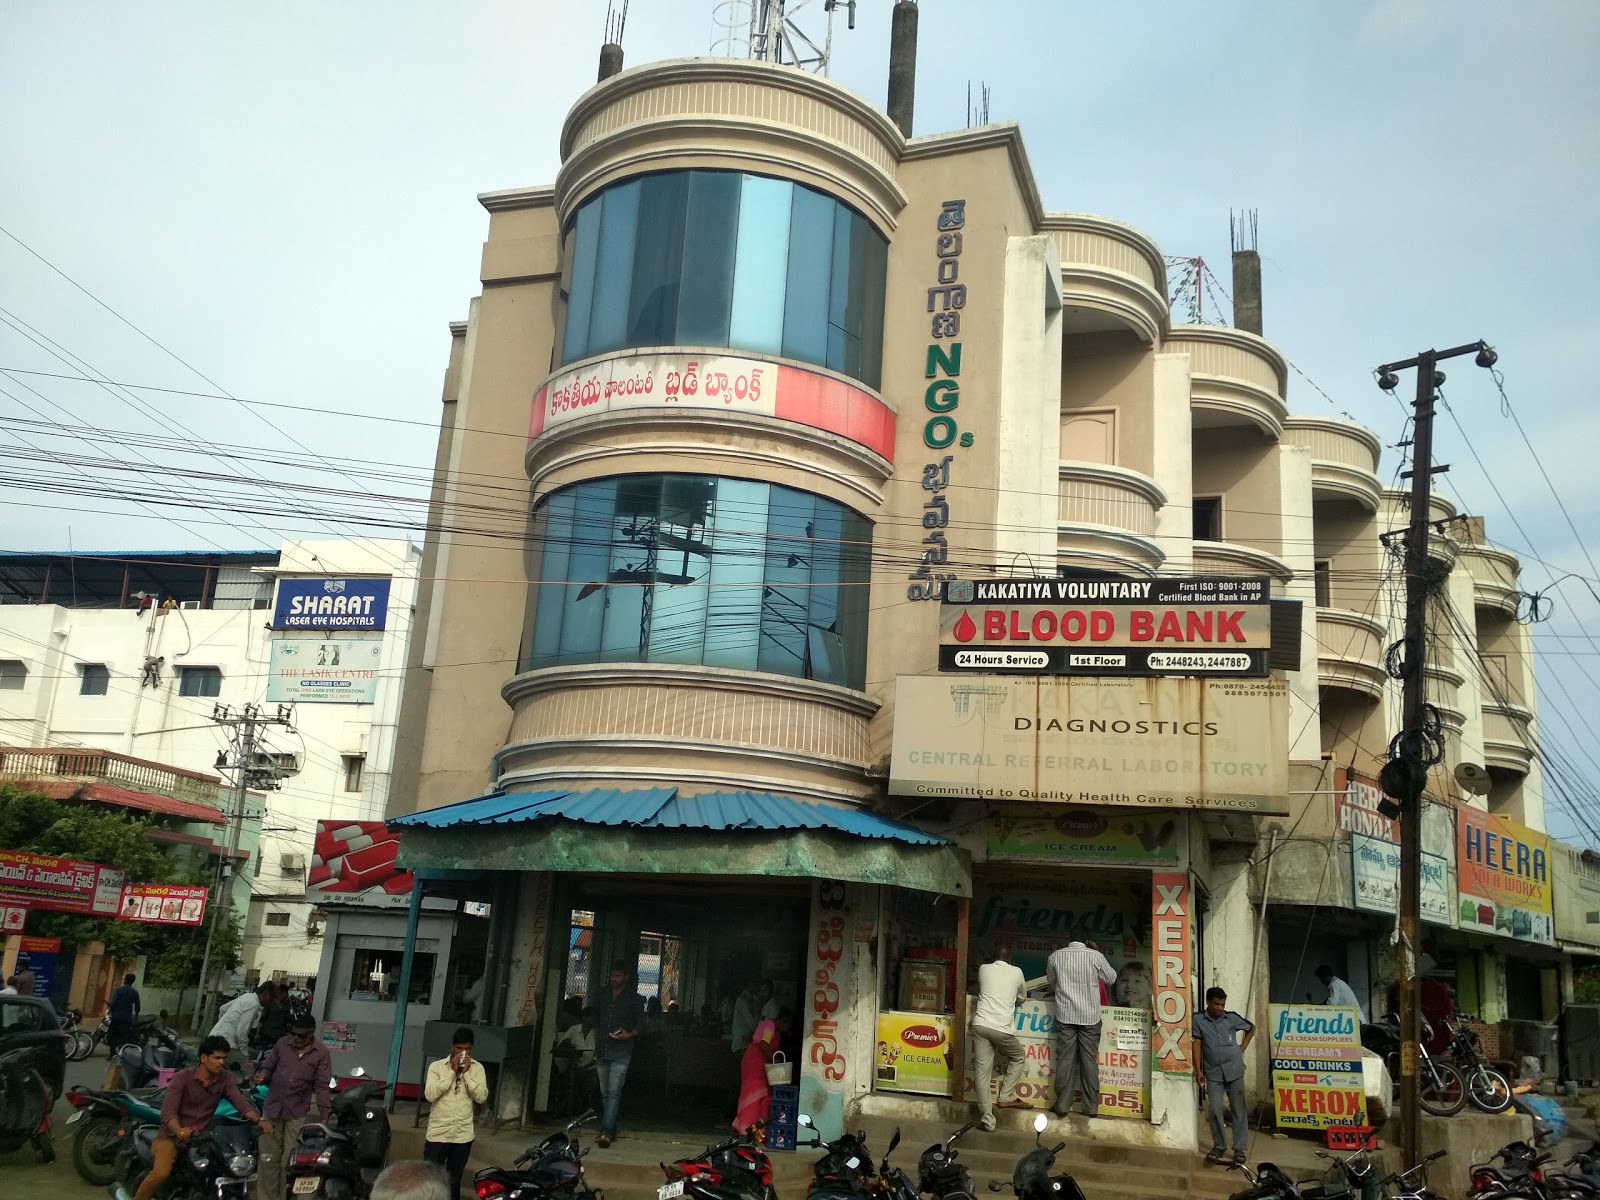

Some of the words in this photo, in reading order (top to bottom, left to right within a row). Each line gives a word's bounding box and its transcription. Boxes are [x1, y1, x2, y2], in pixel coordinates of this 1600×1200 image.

[550, 375, 600, 416] కాకతీయ
[604, 370, 654, 399] వాలంటరీ
[665, 362, 698, 402] బ్లడ్
[706, 368, 763, 404] బ్యాంక్
[978, 582, 1051, 598] KAKATIYA
[1058, 582, 1151, 598] VOLUNTARY
[1180, 582, 1197, 591] First
[1219, 582, 1261, 591] 9001-2008
[290, 596, 375, 614] SHARAT
[1159, 593, 1192, 601] Certified
[1195, 593, 1216, 601] Blood
[1219, 593, 1238, 601] Bank
[285, 617, 310, 625] LASER
[313, 617, 327, 625] EYE
[330, 617, 375, 625] HOSPITALS
[983, 610, 1115, 641] BLOOD
[1130, 610, 1247, 643] BANK
[959, 655, 971, 664] 24
[974, 655, 1003, 664] Hours
[1006, 655, 1044, 665] Service
[1074, 657, 1091, 665] 1st
[1094, 657, 1121, 665] Floor
[1150, 656, 1163, 666] Ph:
[280, 669, 299, 678] THE
[302, 669, 332, 678] LASIK
[335, 669, 375, 679] CENTRE
[1014, 717, 1218, 736] DIAGNOSTICS
[908, 751, 996, 766] CENTRAL
[1005, 754, 1113, 771] REERRAL
[1122, 758, 1267, 776] LABORTORY
[916, 784, 993, 797] Committed
[999, 788, 1013, 797] to
[1019, 789, 1073, 801] Quality
[1079, 792, 1130, 802] Health
[1136, 794, 1173, 804] Care
[1185, 796, 1257, 808] Services
[1346, 781, 1383, 812] HER
[1044, 843, 1066, 851] ICE
[1070, 844, 1117, 852] CREAM
[1465, 824, 1547, 885] HEERA
[1472, 866, 1500, 886] SOFA
[1505, 876, 1542, 899] WORKS
[1154, 884, 1187, 1060] XEROX
[522, 963, 539, 1025] HOTEL
[1013, 1002, 1056, 1032] frie
[1275, 1010, 1354, 1040] friends
[903, 1030, 938, 1042] Premier
[1275, 1046, 1292, 1055] ICE
[1295, 1047, 1342, 1057] CREAMS
[916, 1056, 942, 1065] CREAM
[1097, 1052, 1138, 1069] LIERS
[1275, 1060, 1305, 1070] COOL
[1308, 1061, 1352, 1071] DRINKS
[1099, 1077, 1119, 1086] Party
[1120, 1079, 1145, 1087] Orders
[1110, 1070, 1136, 1079] Accept
[1278, 1088, 1361, 1115] XEROX
